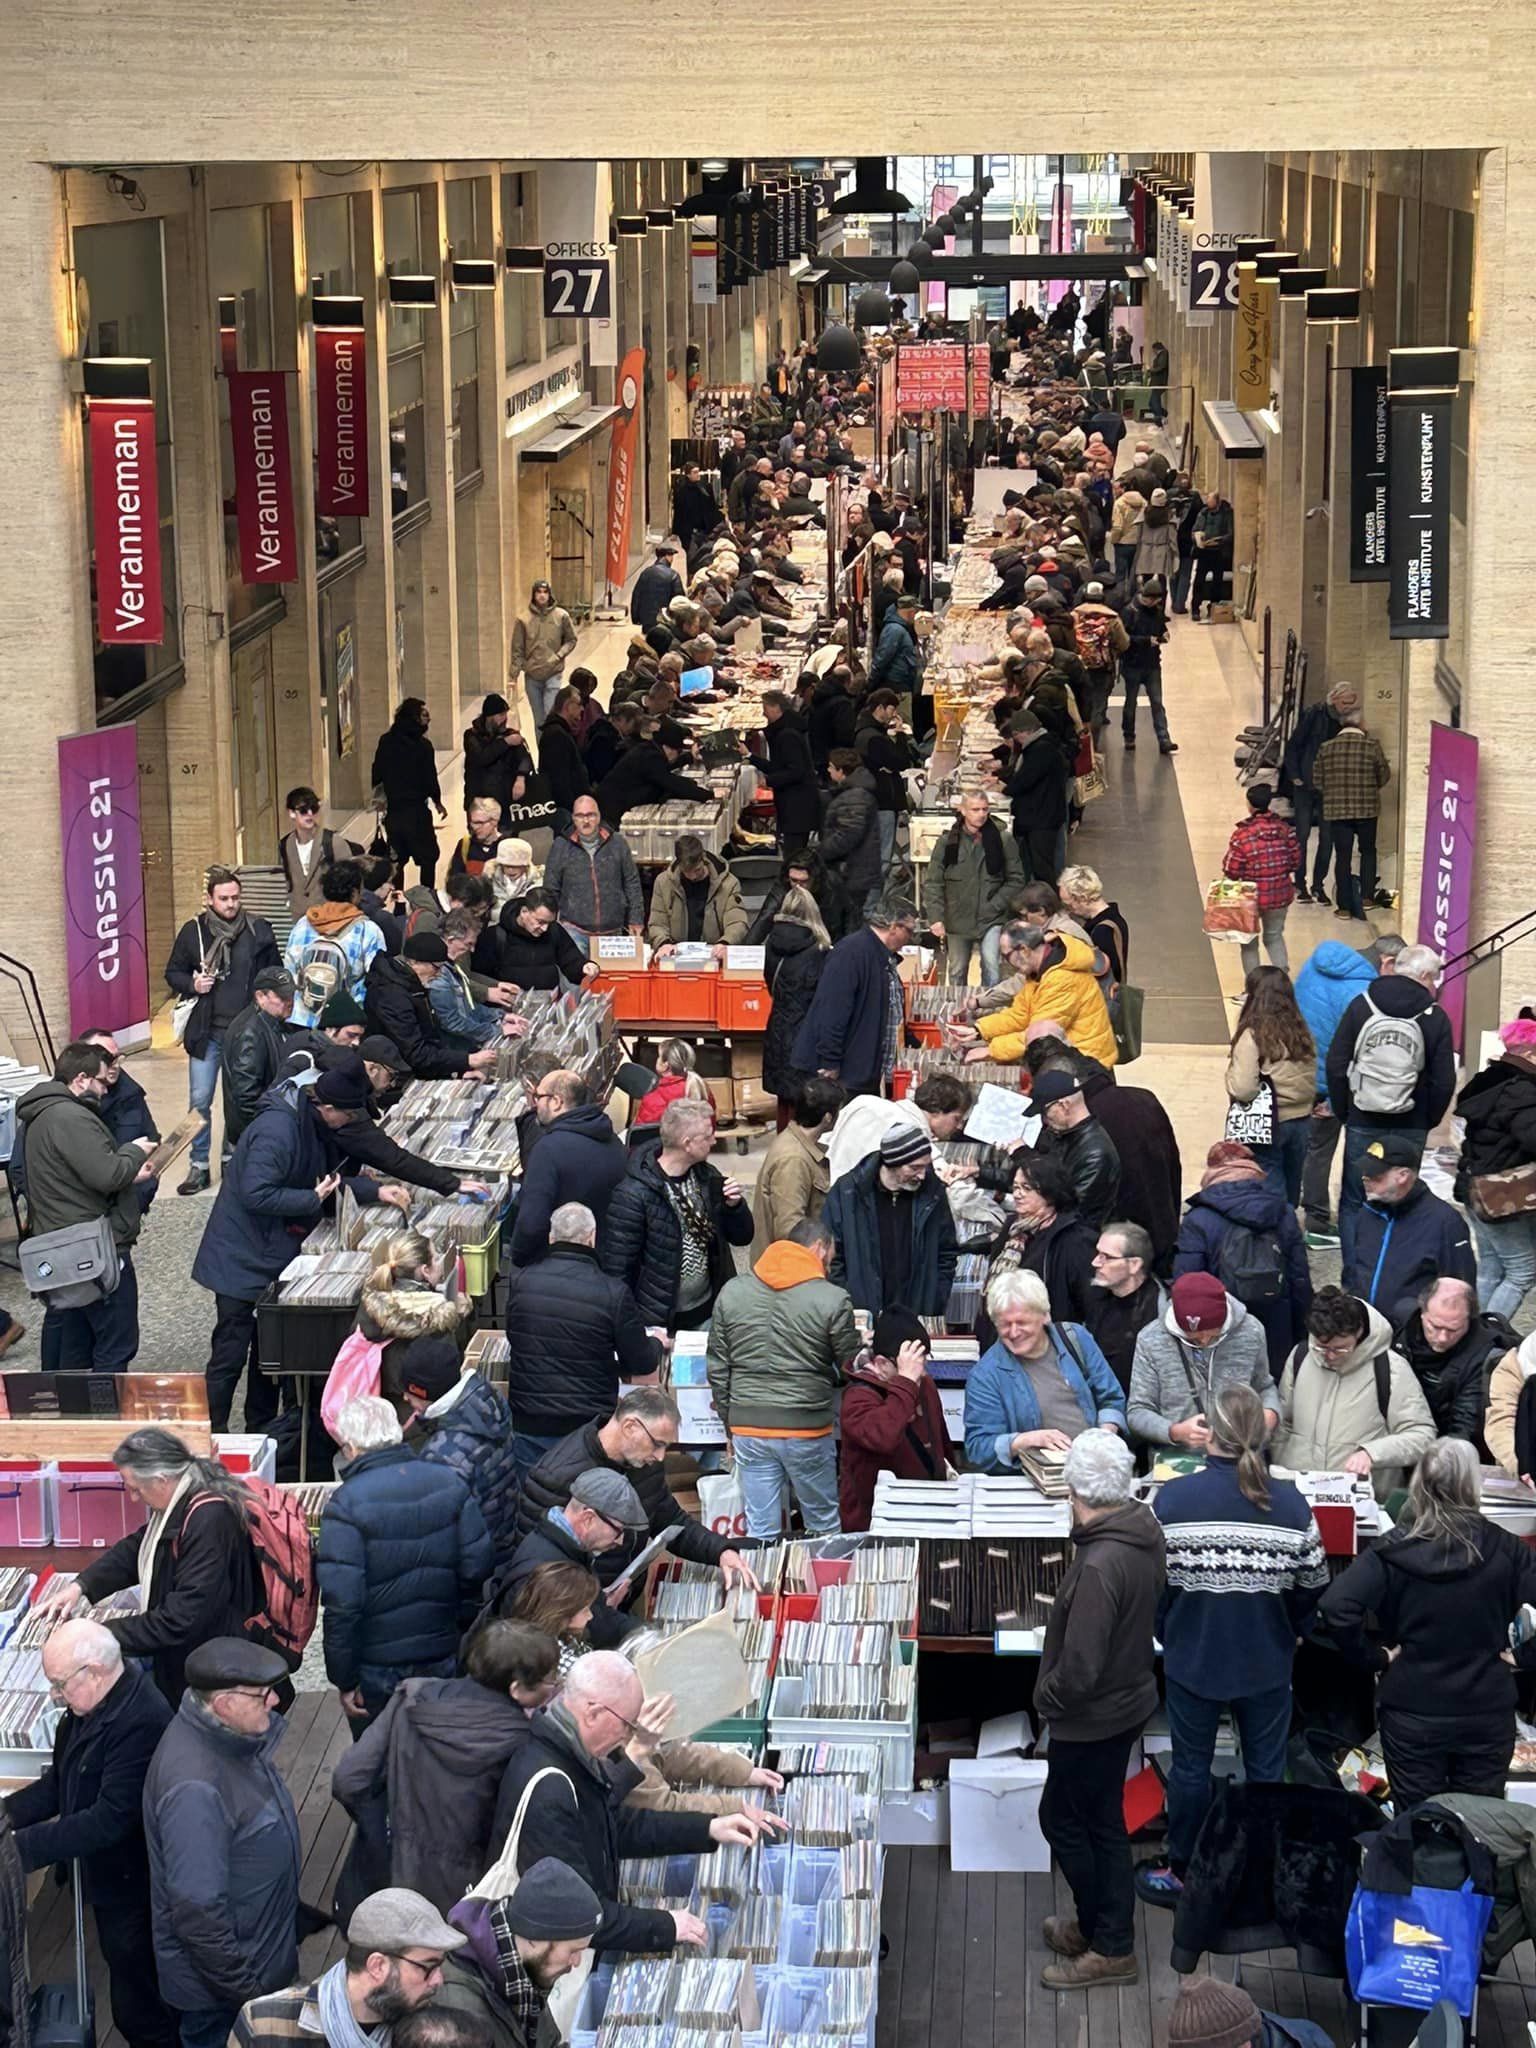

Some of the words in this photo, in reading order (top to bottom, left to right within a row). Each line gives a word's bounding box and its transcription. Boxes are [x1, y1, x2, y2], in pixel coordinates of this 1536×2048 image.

[546, 242, 606, 257] OFFICES
[551, 269, 603, 313] 27
[1195, 260, 1239, 305] 28
[332, 339, 356, 504] Veranneman
[1375, 385, 1387, 463] KUNSTENPUNT
[250, 387, 282, 573] Veranneman
[1421, 412, 1433, 503] KUNSTENPUNT
[114, 418, 145, 632] Veranneman
[1375, 486, 1386, 536] INSTITUTE
[1365, 511, 1376, 564] FLANDERS
[1375, 537, 1386, 564] ARTS
[1420, 530, 1433, 587] INSTITUTE
[1408, 559, 1420, 618] FLANDERS
[1420, 590, 1432, 618] ARTS
[90, 777, 111, 818] 21
[509, 801, 557, 822] fnac
[1442, 779, 1459, 823] 21
[93, 829, 120, 982] CLASSIC
